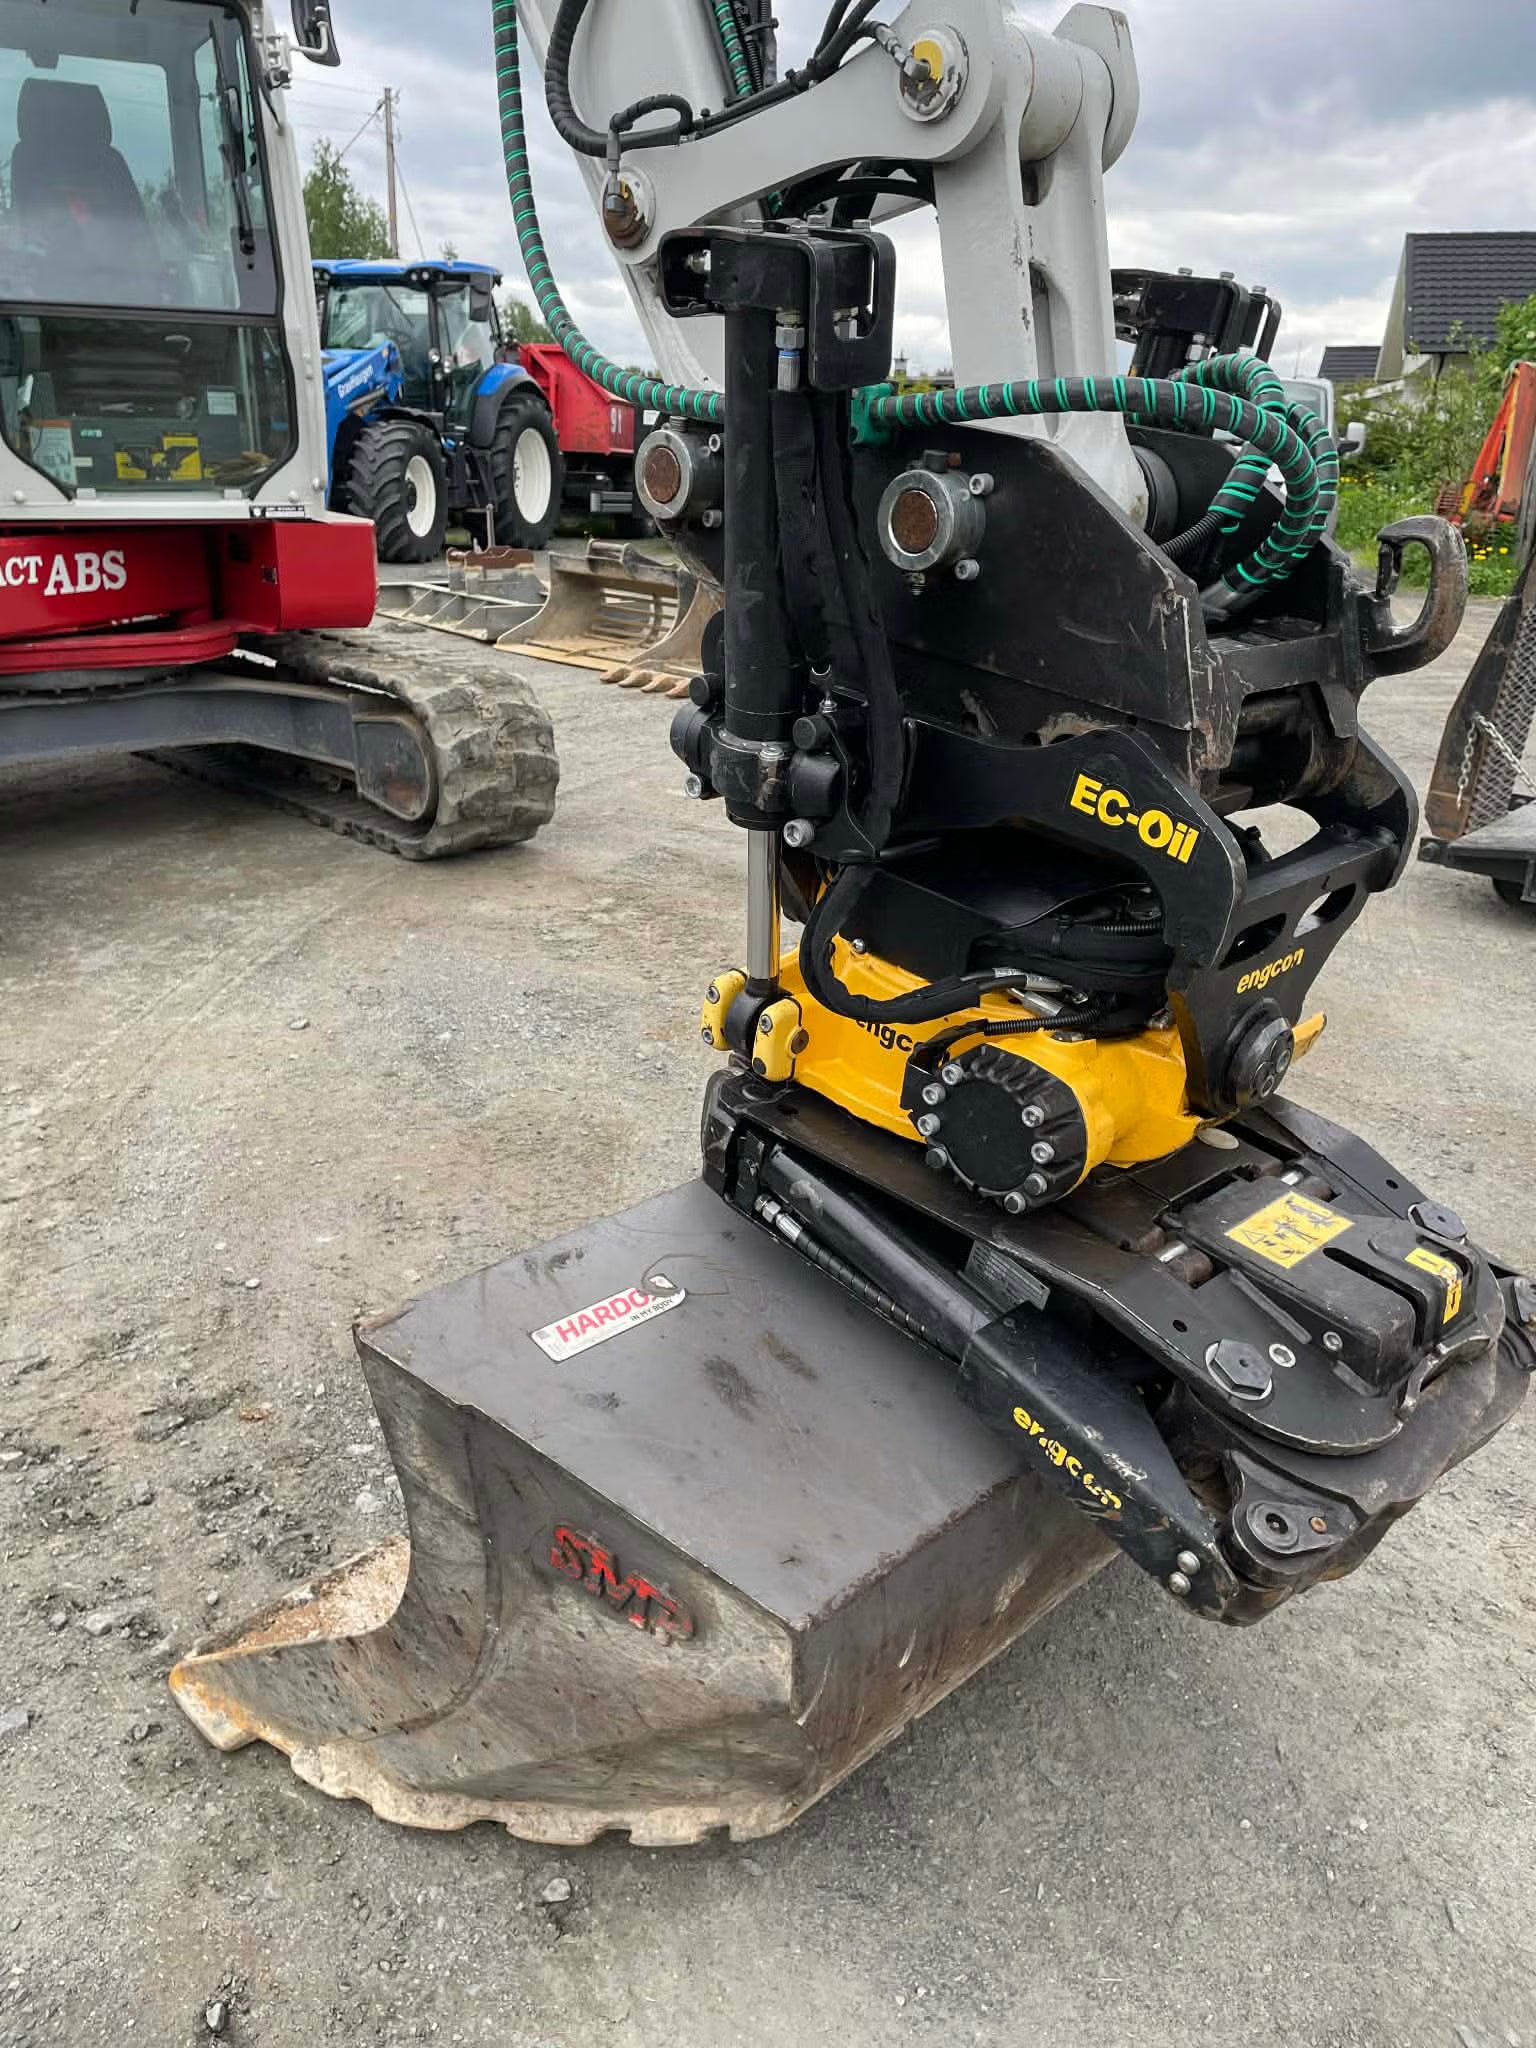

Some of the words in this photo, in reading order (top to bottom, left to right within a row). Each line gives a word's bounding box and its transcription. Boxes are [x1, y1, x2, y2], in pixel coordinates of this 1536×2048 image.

[610, 407, 622, 434] 91
[44, 550, 127, 596] ABS
[1070, 773, 1200, 865] EC-Oil
[1236, 948, 1305, 994] engcon
[555, 1288, 657, 1343] HARDO
